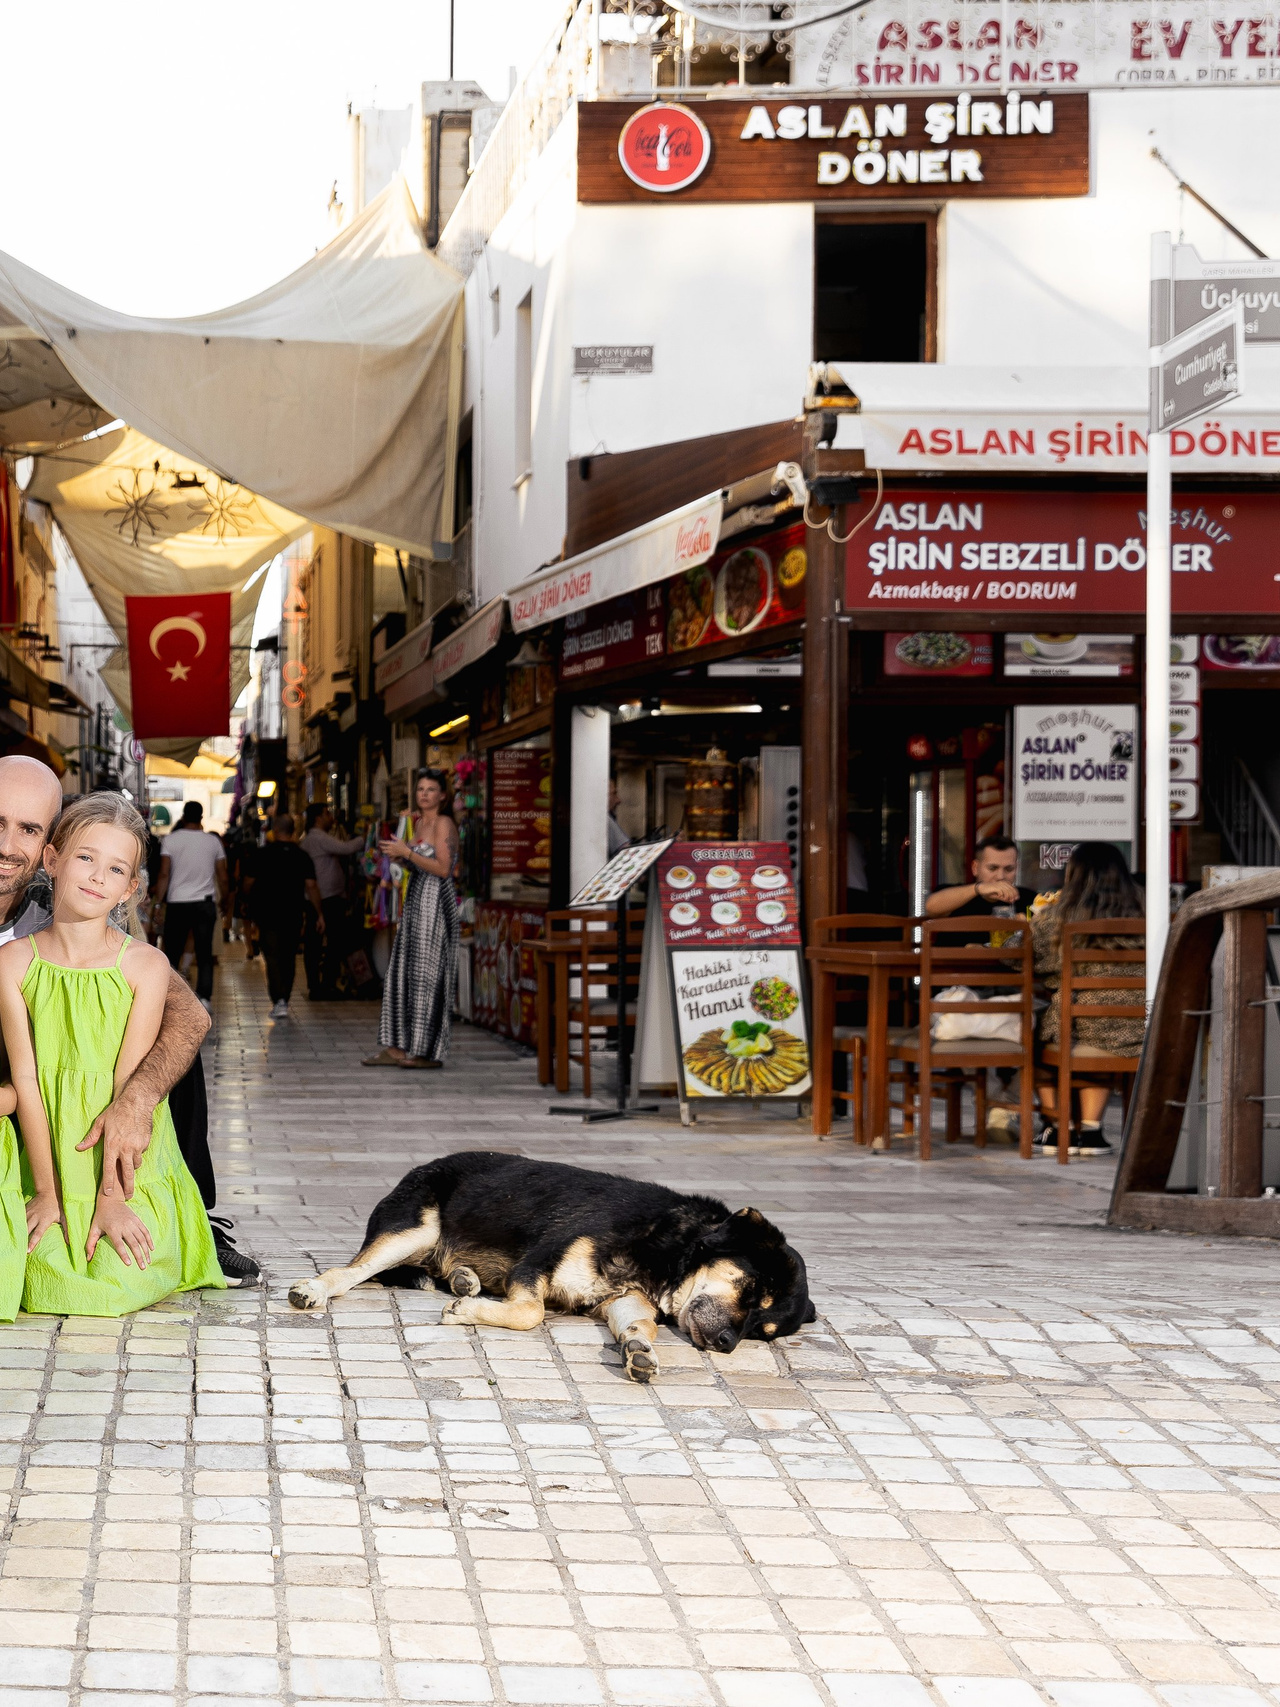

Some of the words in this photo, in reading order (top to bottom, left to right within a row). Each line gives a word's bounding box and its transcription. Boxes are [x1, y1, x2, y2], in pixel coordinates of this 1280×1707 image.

[876, 19, 1041, 52] ASLAN
[1130, 19, 1193, 60] EV
[1213, 17, 1280, 60] YE
[740, 103, 908, 140] ASLAN
[923, 90, 1055, 144] ŞİRİN
[817, 138, 986, 185] DÖNER
[1175, 341, 1227, 386] Cumhuriyet
[898, 428, 1036, 456] ASLAN
[1048, 421, 1148, 464] ŞİRİN
[874, 502, 984, 532] ASLAN
[867, 536, 953, 576] ŞİRİN
[960, 536, 1086, 572] SEBZELİ
[1094, 538, 1215, 572] DÖER
[868, 581, 970, 603] Azmakbaşı
[986, 582, 1078, 601] BODRUM
[1036, 709, 1115, 735] meşhur
[1022, 736, 1077, 755] ASLAN
[1021, 758, 1065, 786] ŞİRİN
[1070, 758, 1128, 782] DÖNER
[682, 958, 733, 981] Hakiki
[677, 973, 751, 1000] Karadeniz
[684, 992, 745, 1021] Hamsi
